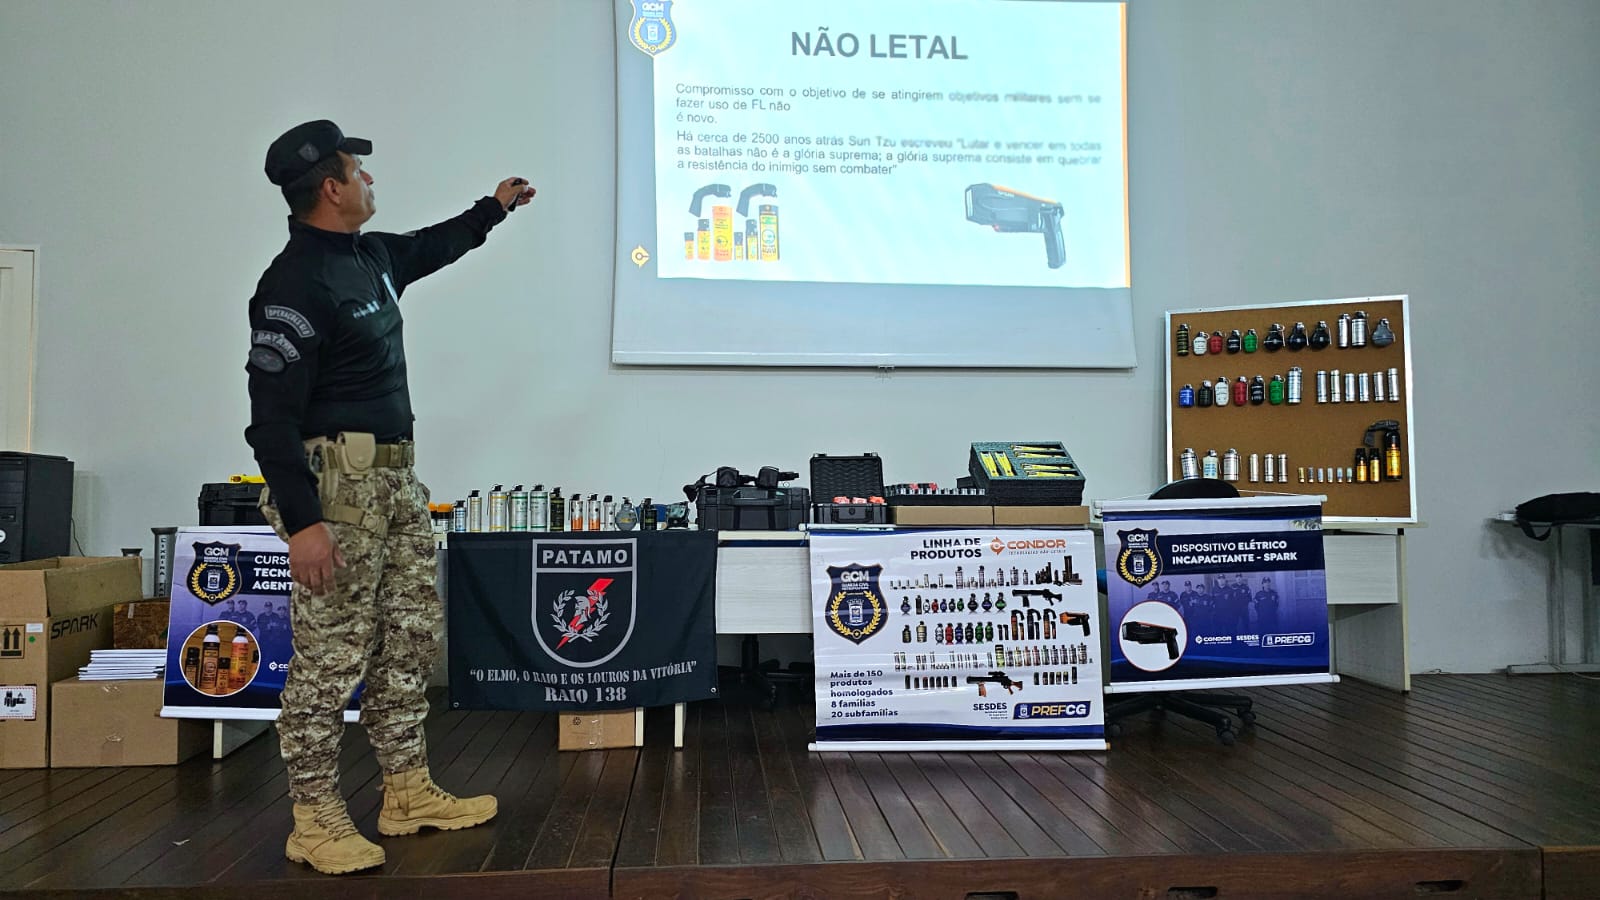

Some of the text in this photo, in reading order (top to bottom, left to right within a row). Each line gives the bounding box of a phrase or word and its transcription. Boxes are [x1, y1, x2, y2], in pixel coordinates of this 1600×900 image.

[791, 26, 968, 60] NÃO LETAL
[676, 82, 1101, 104] Compromisso com o objetivo de se atingirem objetivos militares sem se
[676, 97, 791, 111] fazer uso de FL não
[676, 111, 718, 124] é novo.
[676, 130, 693, 142] Há
[697, 133, 728, 143] cerca
[732, 131, 748, 143] de
[751, 133, 780, 144] 2500
[783, 135, 812, 145] anos
[815, 134, 844, 146] atrás
[848, 135, 871, 147] Sun
[875, 136, 896, 147] Tzu
[900, 138, 953, 149] escreveu
[994, 141, 1002, 150] e
[1005, 141, 1044, 150] vencer
[1048, 142, 1066, 151] em
[1071, 139, 1102, 151] todas
[677, 145, 1101, 167] as batalhas não é a glória suprema; a glória suprema consiste em quebrar
[677, 160, 684, 169] a
[687, 158, 748, 171] resistência
[752, 161, 765, 171] do
[769, 161, 809, 175] inimigo
[812, 164, 836, 174] sem
[923, 537, 981, 549] LINHA DE
[1127, 533, 1149, 542] GCM
[1007, 539, 1066, 550] CONDOR
[1172, 539, 1287, 553] DISPOSITIVO ELÉTRICO
[204, 547, 229, 557] GCM
[542, 549, 628, 565] PATAMO
[911, 548, 982, 560] PRODUTOS
[1172, 553, 1254, 565] INCAPACITANTE
[1263, 552, 1297, 562] SPARK
[840, 570, 870, 582] GCM
[51, 613, 98, 640] SPARK
[1274, 635, 1312, 645] PREFCG
[487, 669, 520, 683] ELMO,
[523, 671, 531, 682] O
[532, 671, 558, 685] RAIO
[560, 673, 568, 685] E
[570, 673, 585, 685] OS
[588, 671, 630, 684] LOUROS
[632, 669, 648, 682] DA
[830, 670, 852, 678] Mais
[853, 670, 865, 678] de
[830, 679, 873, 689] produtos
[545, 686, 627, 704] RAIO 138
[830, 688, 894, 698] homologados
[831, 699, 876, 708] 8 famílias
[973, 702, 1087, 716] SESDES PREFCG
[845, 708, 899, 718] subfamílias
